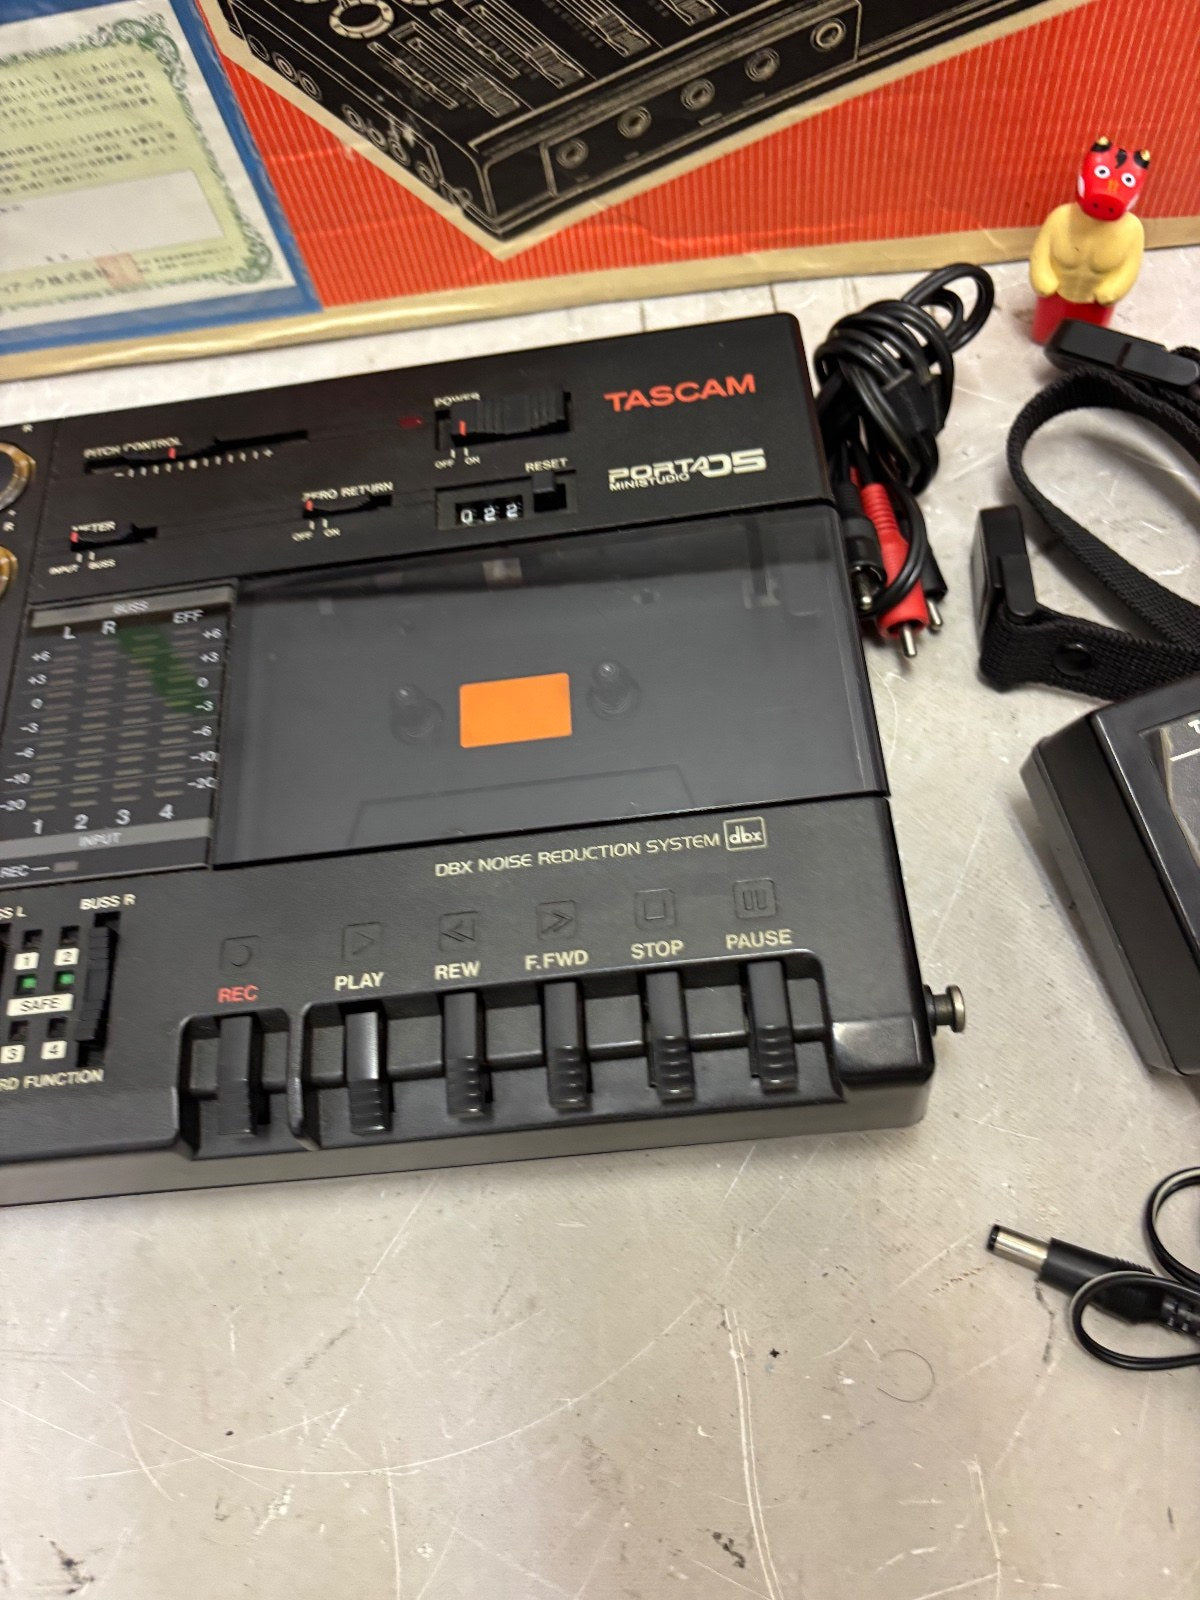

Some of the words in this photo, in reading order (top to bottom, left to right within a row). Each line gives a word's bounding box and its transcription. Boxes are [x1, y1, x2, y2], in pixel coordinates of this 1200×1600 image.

[603, 373, 757, 412] TASCAM
[524, 457, 569, 473] RESET
[340, 481, 394, 497] RETURN
[609, 472, 690, 492] MINISTUDIO
[63, 626, 76, 640] L
[101, 620, 117, 635] R
[173, 610, 203, 624] EFF
[33, 819, 45, 835] 1
[73, 813, 89, 831] 2
[115, 808, 132, 826] 3
[157, 803, 175, 820] 4
[79, 832, 122, 849] INPUT
[435, 861, 473, 877] DBX
[478, 854, 533, 873] NOISE
[537, 841, 641, 866] REDUCTION
[646, 832, 720, 854] SYSTEM
[79, 894, 121, 911] BUSS
[122, 893, 137, 907] R
[725, 928, 793, 950] PAUSE
[524, 949, 590, 971] F.FWD
[630, 940, 685, 960] STOP
[434, 960, 481, 980] REW
[334, 971, 385, 991] PLAY
[217, 984, 259, 1003] REC
[20, 997, 62, 1013] SAFE
[23, 1069, 104, 1088] FUNCTION
